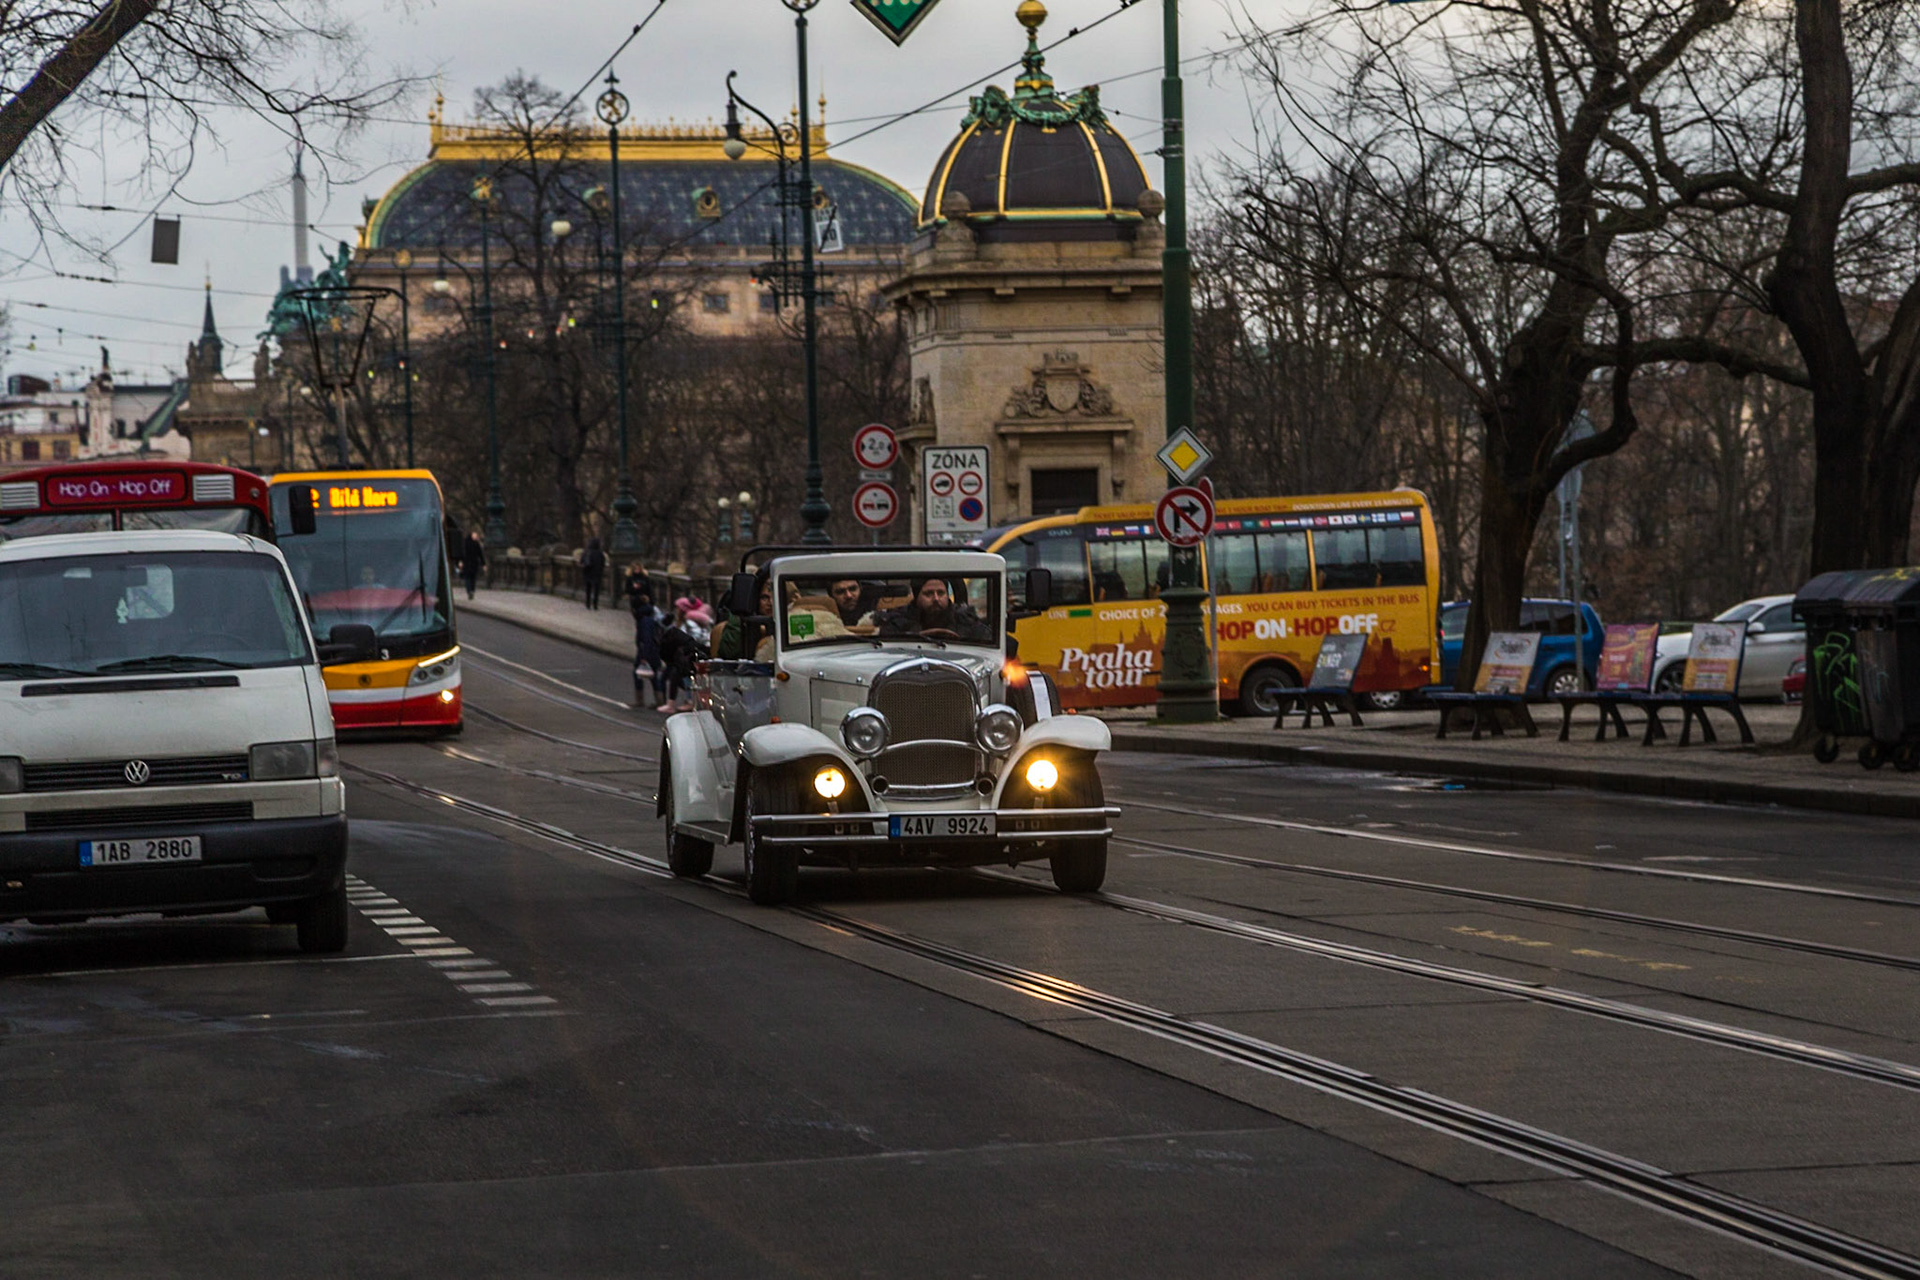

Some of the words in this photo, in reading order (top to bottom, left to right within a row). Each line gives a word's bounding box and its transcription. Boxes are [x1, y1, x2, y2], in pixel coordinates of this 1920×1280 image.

[59, 482, 87, 497] Hop
[90, 480, 109, 496] On
[119, 480, 146, 496] Hop
[150, 479, 171, 494] Off
[1246, 601, 1269, 612] YOU
[1271, 600, 1294, 611] CAN
[1295, 599, 1318, 610] BUY
[1320, 597, 1360, 609] TICKETS
[1363, 596, 1374, 606] IN
[1376, 594, 1396, 605] THE
[1398, 593, 1420, 604] BUS
[1099, 608, 1138, 620] CHOICE
[1141, 607, 1156, 618] OF
[381, 649, 390, 660] 3
[1058, 643, 1154, 672] Praha
[1085, 667, 1151, 689] tour
[904, 817, 934, 834] 4AV
[947, 817, 989, 834] 9924
[97, 842, 131, 862] 1AB
[146, 839, 193, 859] 2880
